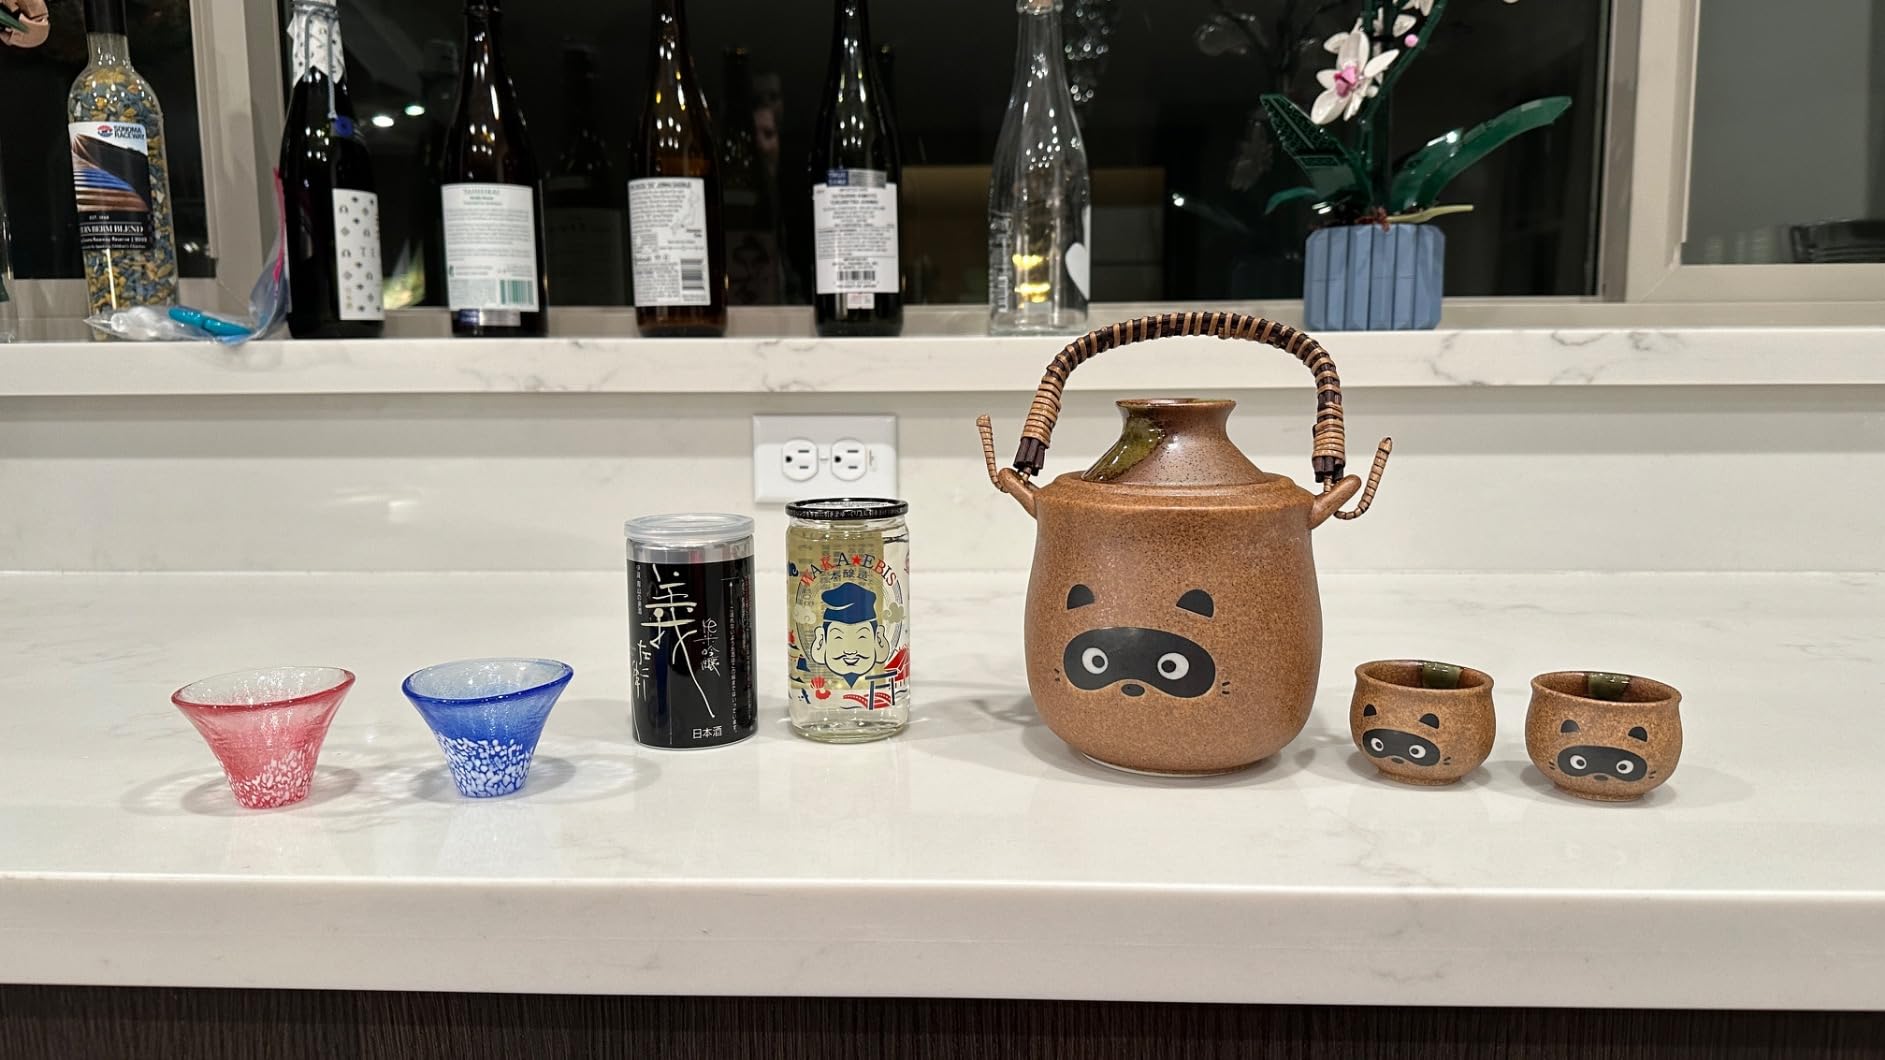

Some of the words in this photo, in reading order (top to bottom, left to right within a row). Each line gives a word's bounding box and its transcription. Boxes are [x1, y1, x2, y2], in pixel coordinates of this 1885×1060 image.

[113, 125, 142, 134] SONOMA
[114, 131, 145, 140] RACEWAY
[114, 224, 144, 233] BLEND
[801, 552, 850, 587] WAKA
[862, 554, 896, 586] EBIS
[692, 725, 723, 740] 日本酒
